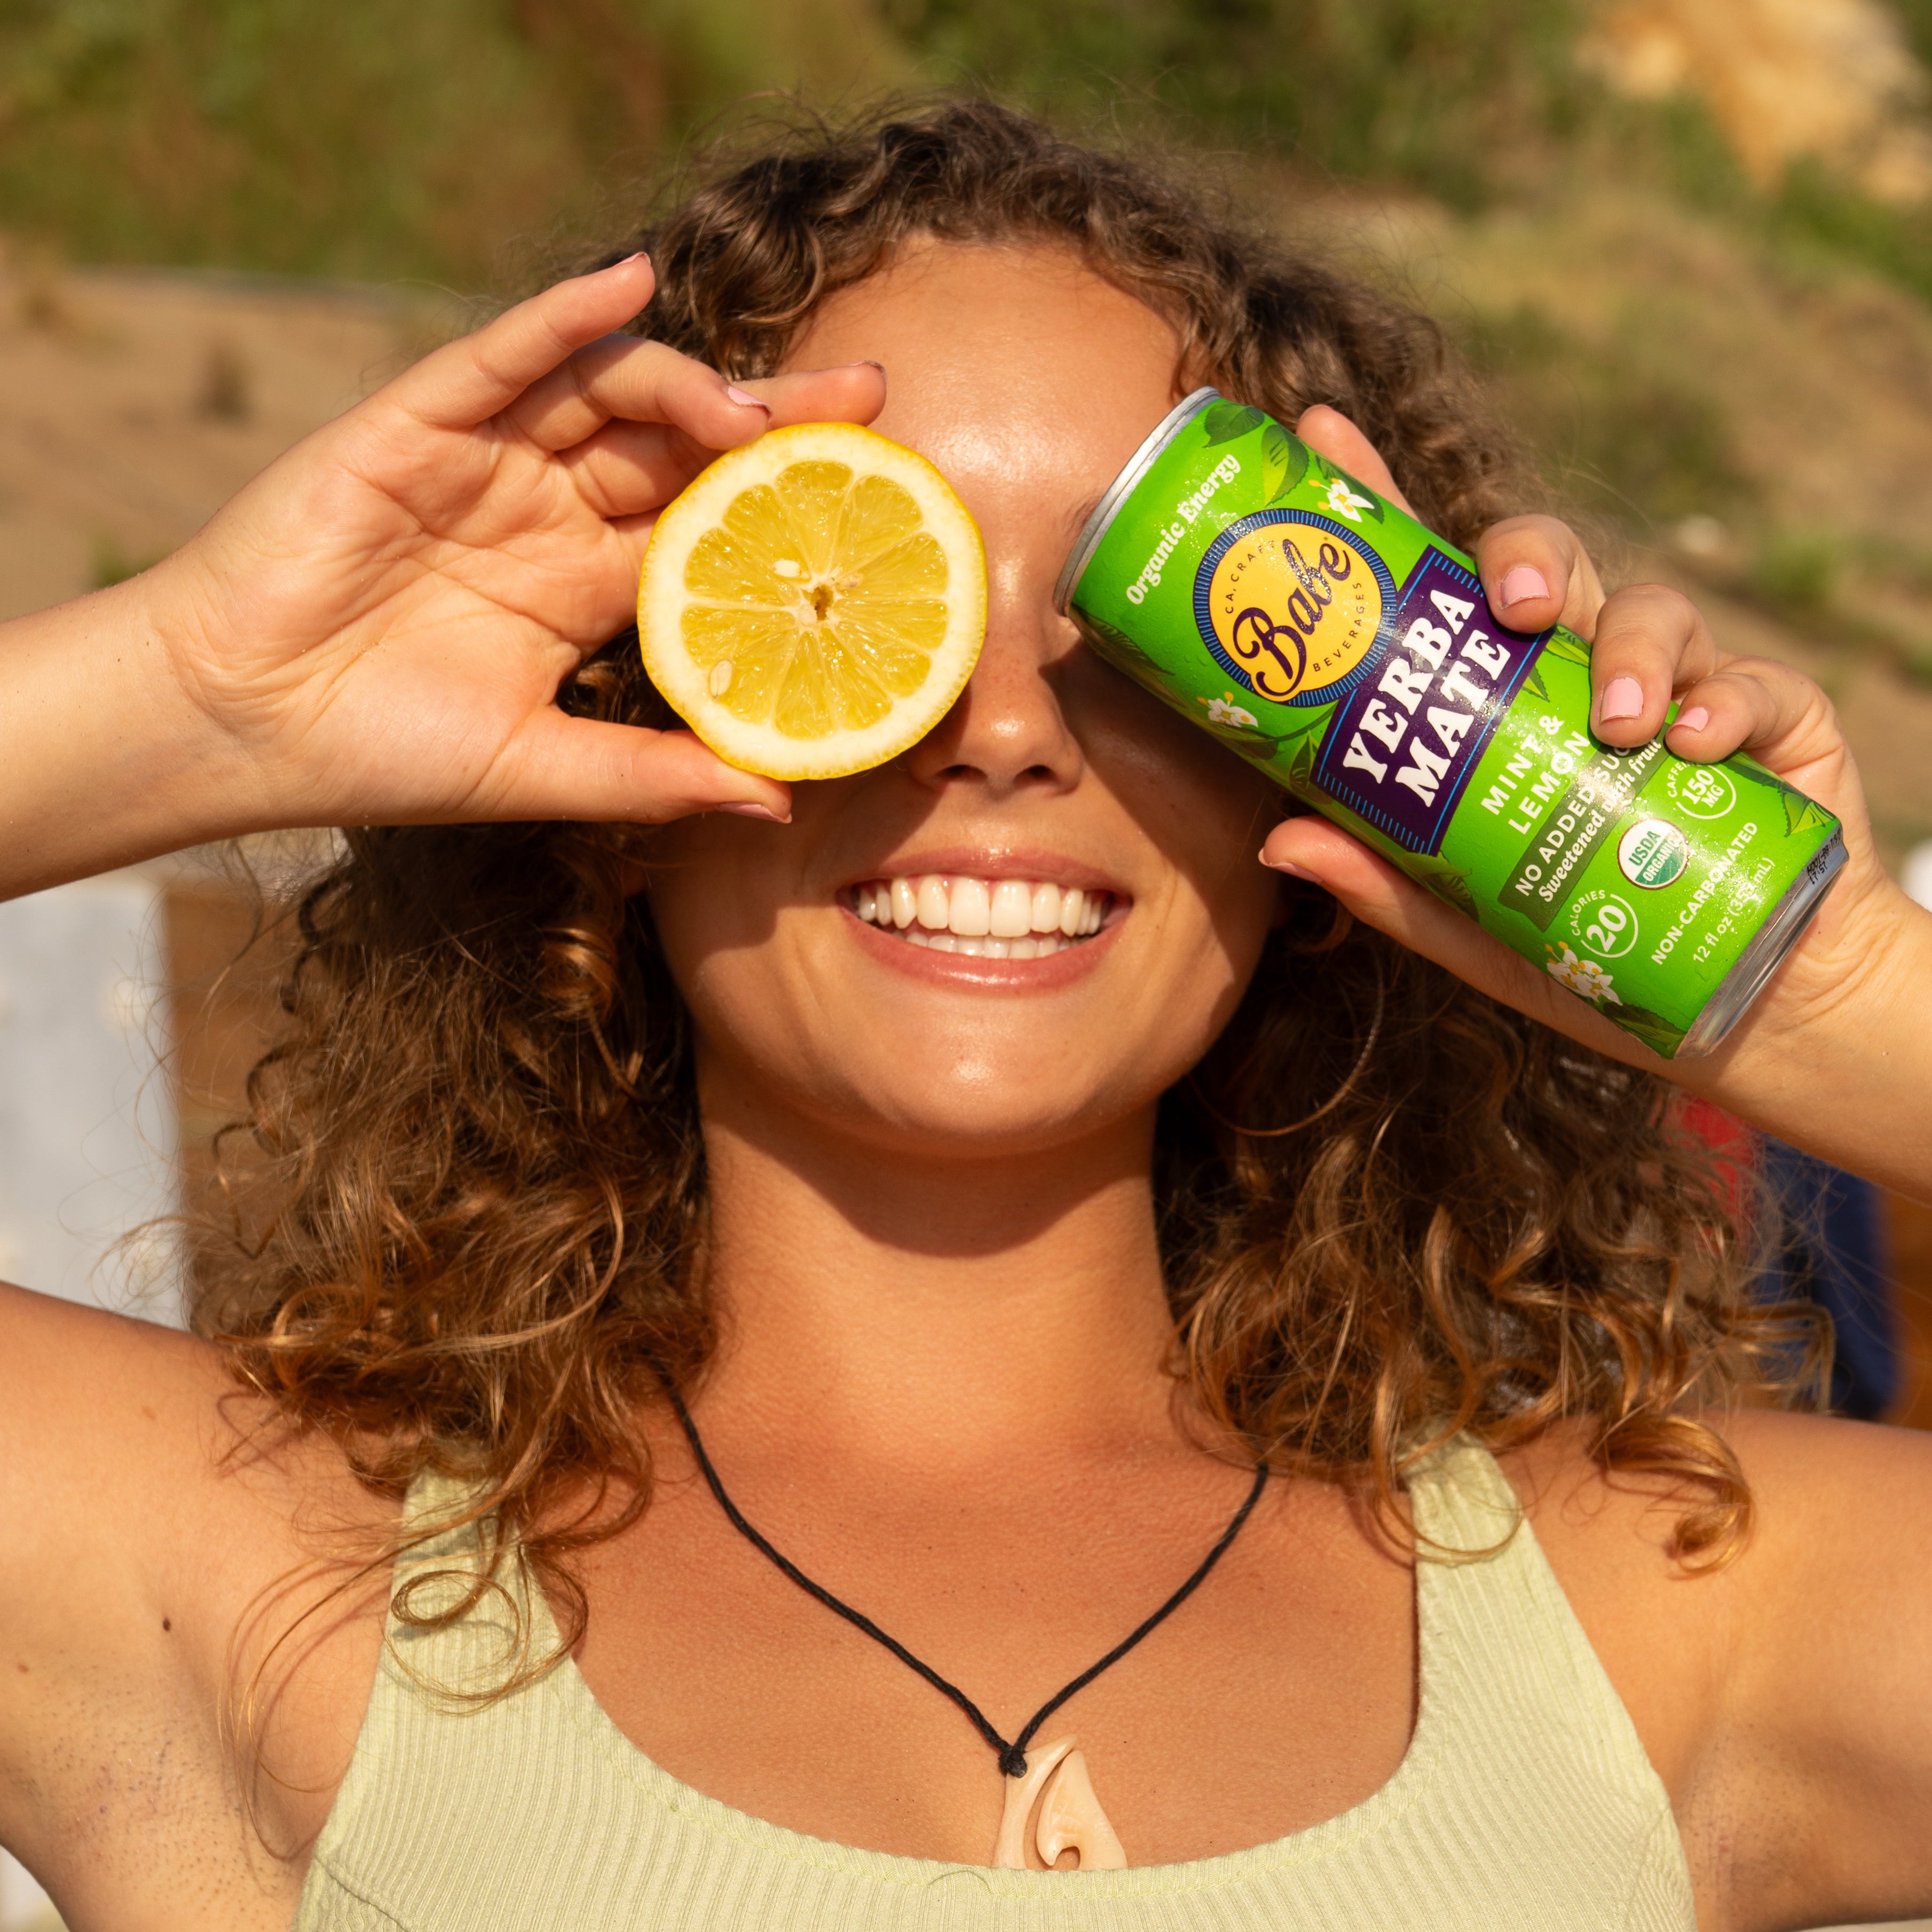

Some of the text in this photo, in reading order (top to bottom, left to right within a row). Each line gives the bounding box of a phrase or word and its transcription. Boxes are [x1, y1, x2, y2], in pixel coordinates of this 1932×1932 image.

[1126, 454, 1241, 605] Organic Energy
[1231, 540, 1274, 582] CRAFT
[1232, 538, 1351, 697] Babe
[1312, 582, 1365, 672] BEVERAGES
[1343, 589, 1475, 784] YERBA
[1394, 629, 1511, 808] MATE
[1481, 715, 1565, 816] MINT &
[1508, 730, 1591, 835] LEMON
[1682, 769, 1715, 805] 150
[1701, 784, 1725, 808] MG
[1515, 864, 1542, 897] NO
[1539, 786, 1596, 864] ADDED
[1538, 738, 1662, 903] Sweetened with fruit
[1629, 830, 1661, 866] USDA
[1642, 836, 1681, 882] ORGANIC
[1570, 889, 1606, 936] CALORIES
[1586, 904, 1627, 953] 20
[1651, 822, 1757, 965] NON-CARBONATED
[1693, 945, 1711, 963] 12
[1705, 932, 1720, 947] fl
[1717, 916, 1733, 934] oz
[1753, 857, 1776, 884] mL)
